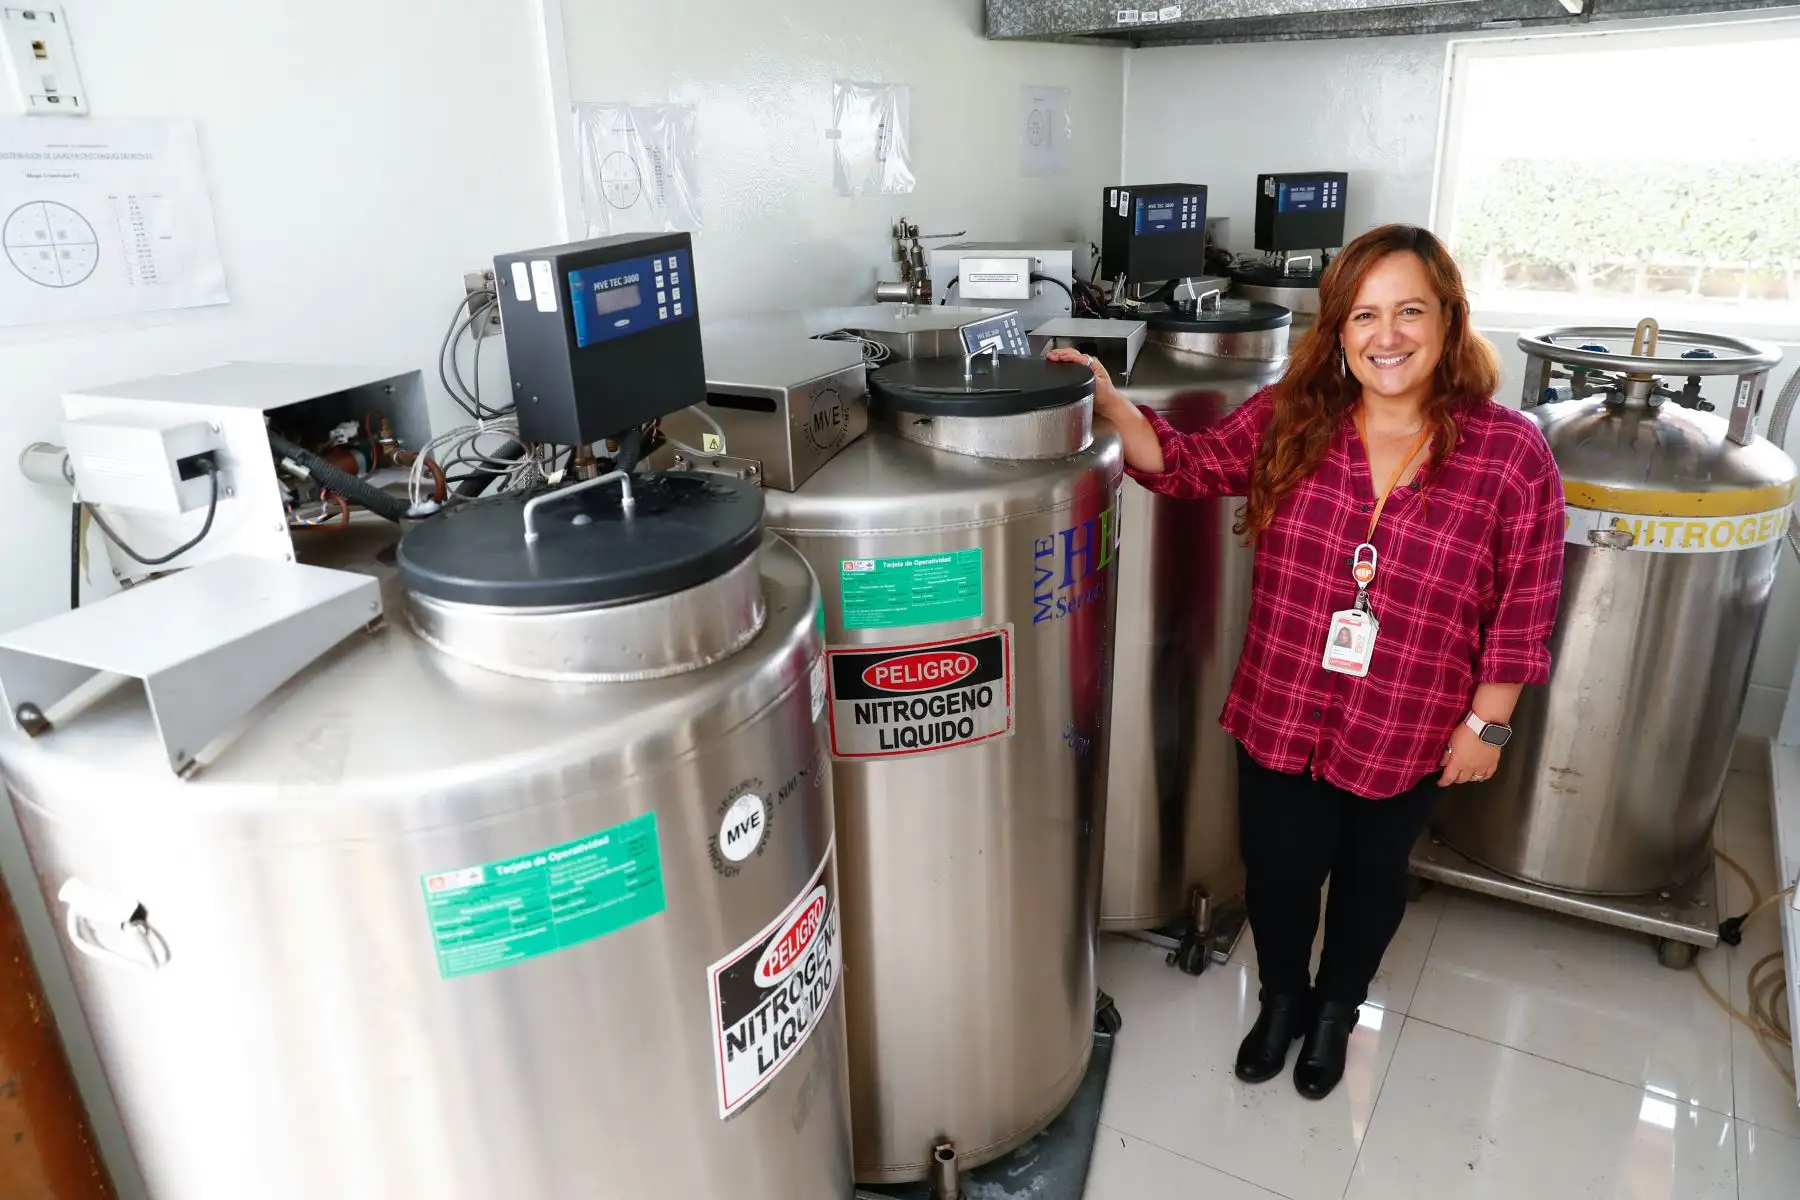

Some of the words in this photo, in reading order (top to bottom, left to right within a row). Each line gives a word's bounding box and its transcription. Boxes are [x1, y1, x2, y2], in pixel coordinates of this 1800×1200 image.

[593, 281, 608, 292] MVE
[610, 277, 622, 288] TEC
[623, 273, 640, 285] 3000
[813, 405, 840, 433] MVE
[913, 556, 952, 567] Operatividad
[1033, 534, 1055, 624] MVE
[875, 656, 970, 686] PELIGRO
[854, 686, 993, 725] NITROGENO
[879, 716, 974, 750] LIQUIDO
[727, 811, 760, 845] MVE
[496, 860, 532, 876] Tarjeta
[533, 856, 547, 867] de
[708, 833, 740, 877] THROUGH
[768, 899, 822, 977] PELIGRO
[726, 903, 837, 1063] NITROGENO
